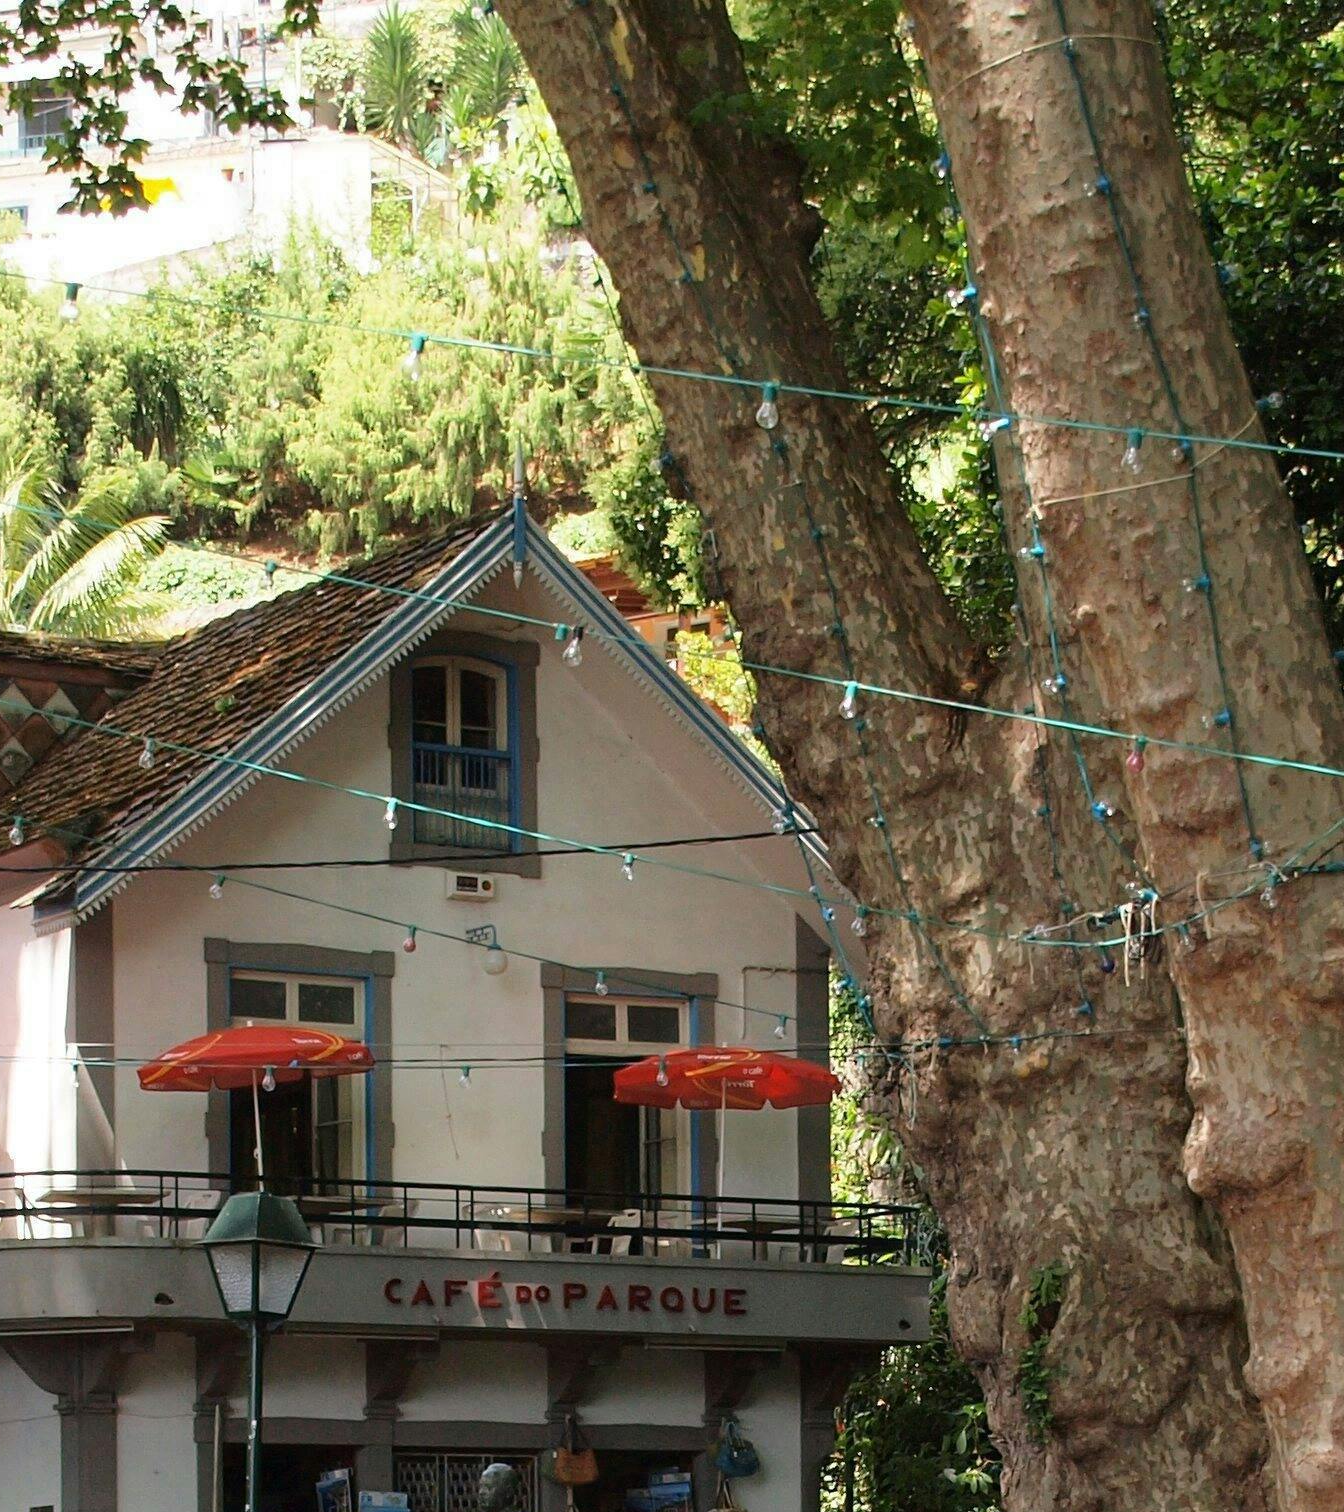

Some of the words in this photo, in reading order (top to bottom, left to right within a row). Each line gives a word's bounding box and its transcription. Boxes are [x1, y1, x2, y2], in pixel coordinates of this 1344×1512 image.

[383, 1271, 503, 1309] CAFÉ
[515, 1284, 552, 1304] DO
[562, 1282, 749, 1316] PARQUE
